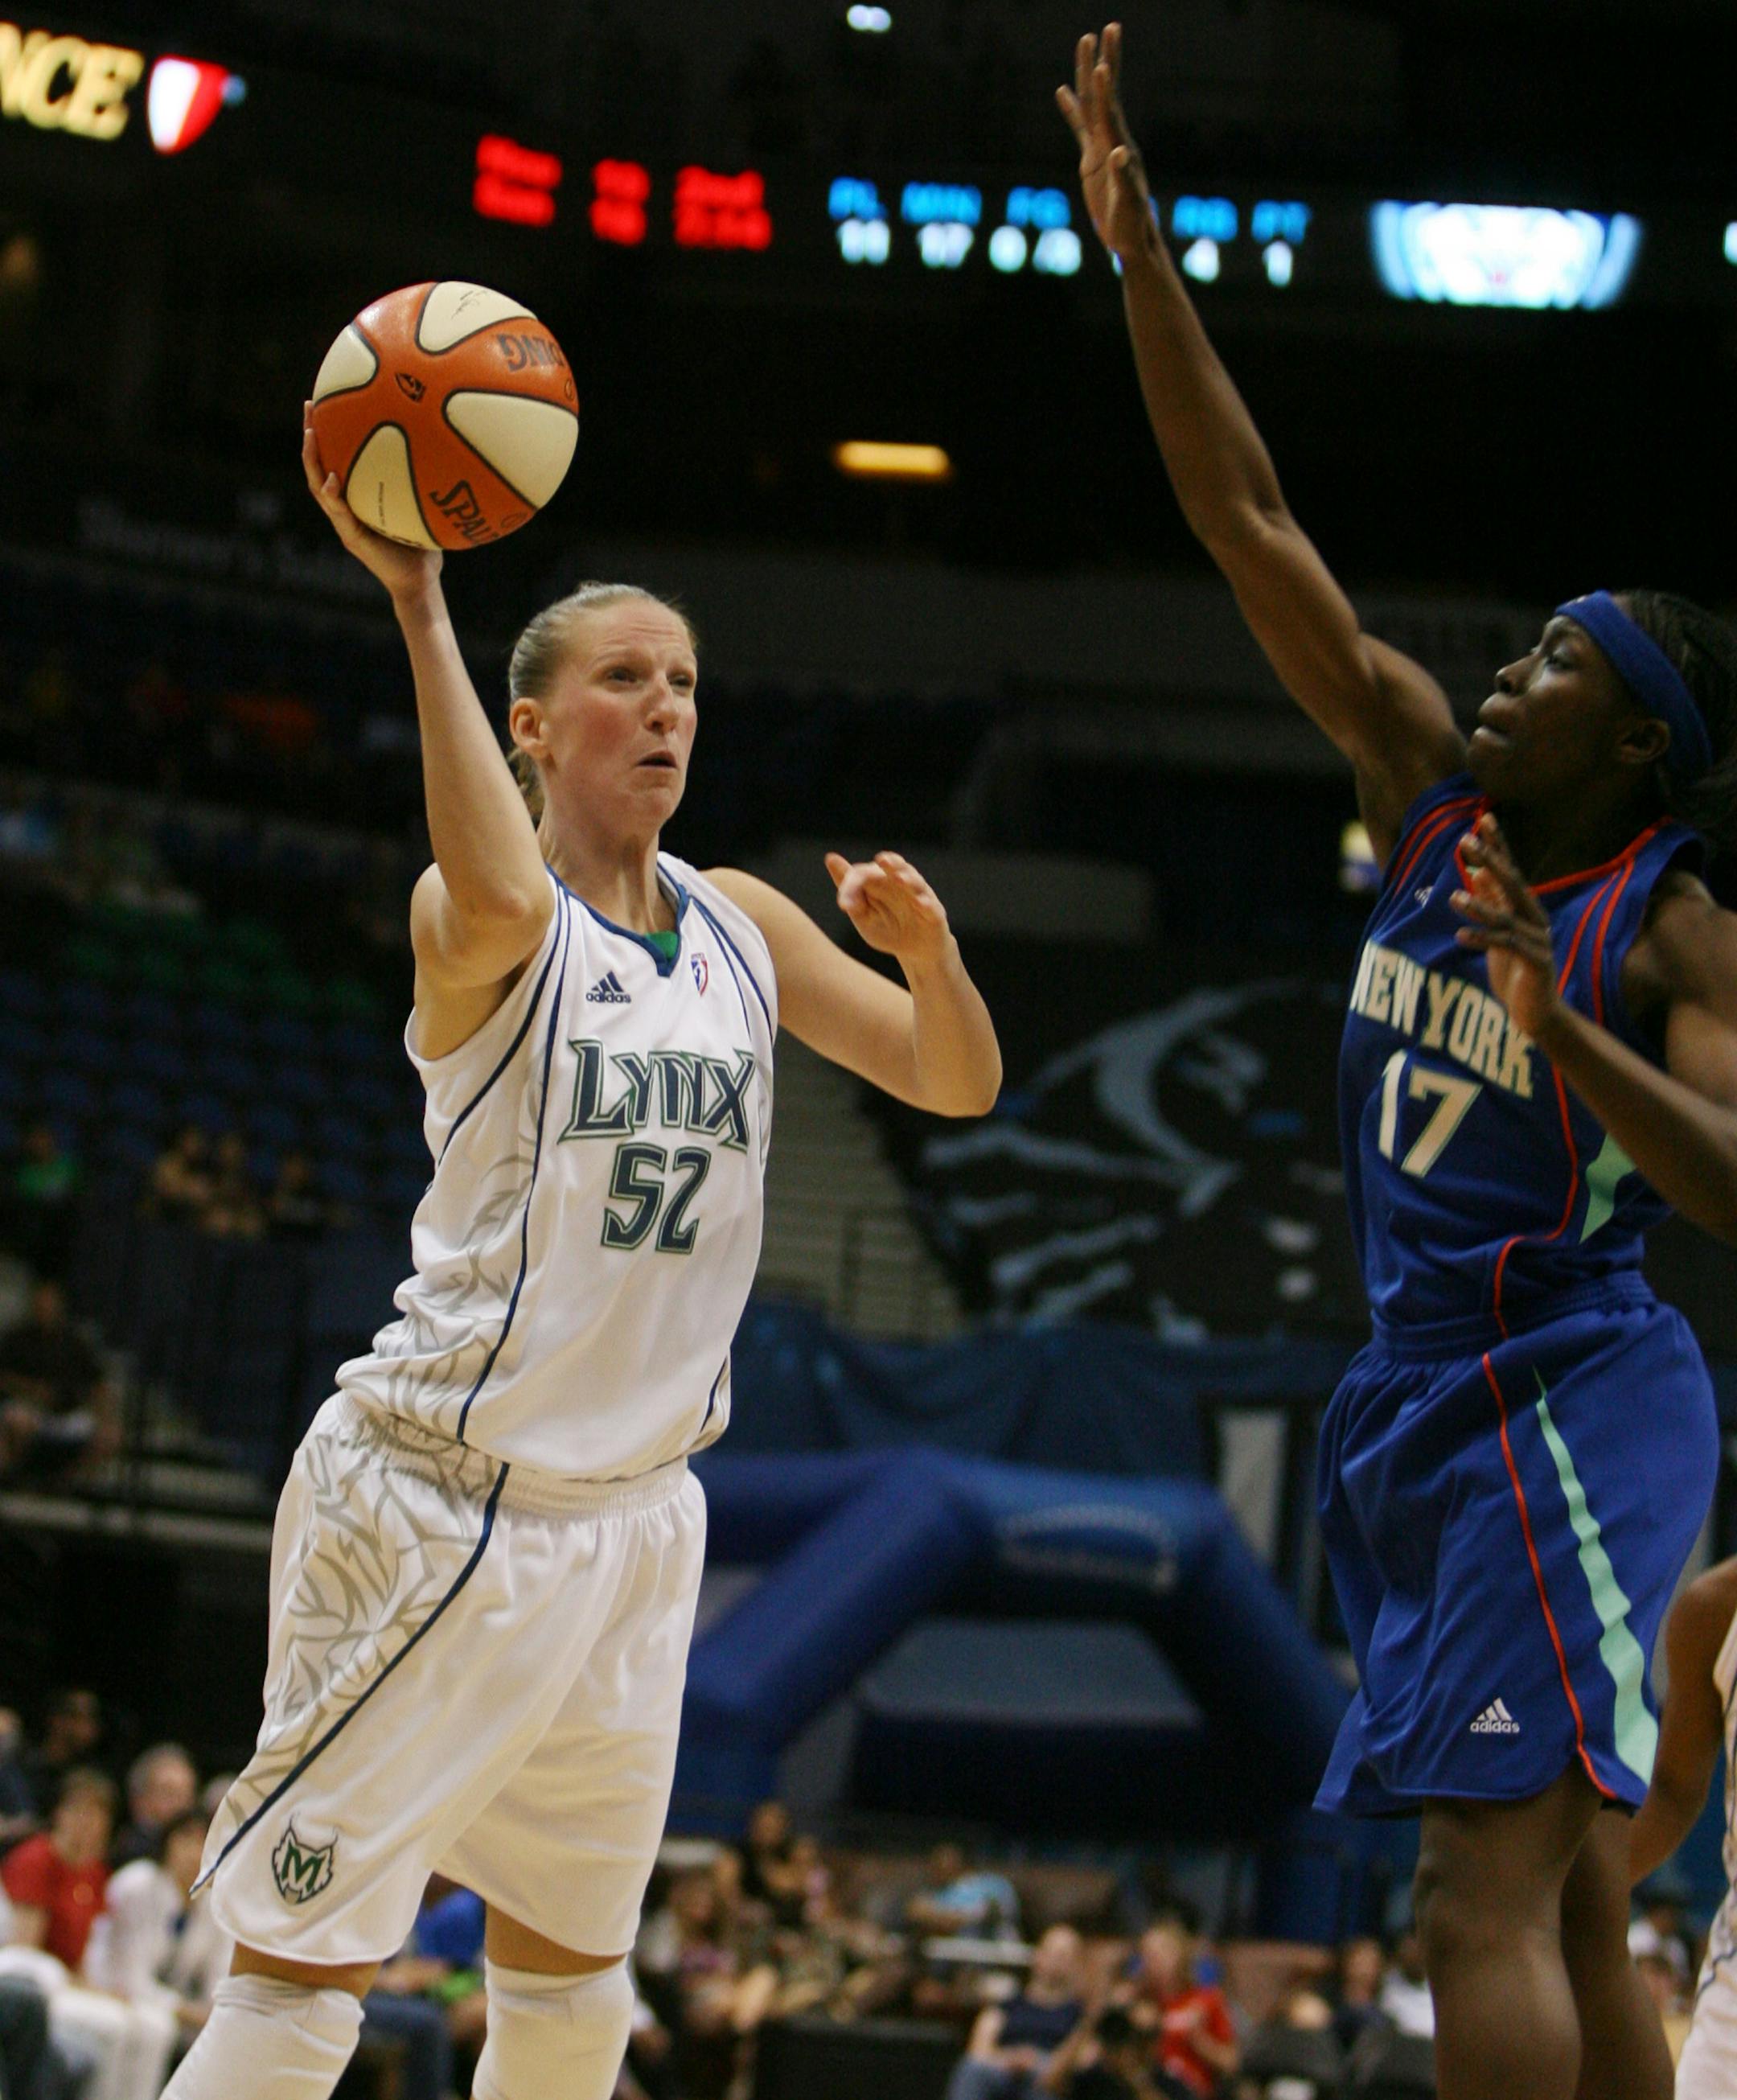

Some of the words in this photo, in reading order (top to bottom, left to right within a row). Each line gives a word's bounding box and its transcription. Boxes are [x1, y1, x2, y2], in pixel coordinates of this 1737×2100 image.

[585, 990, 632, 1004] adidas
[1350, 937, 1427, 1037] NEW
[1420, 972, 1534, 1100] YORK
[557, 1038, 758, 1154] LYNX
[1378, 1048, 1484, 1178] 17
[601, 1141, 712, 1255] 52
[1470, 1720, 1521, 1734] adidas
